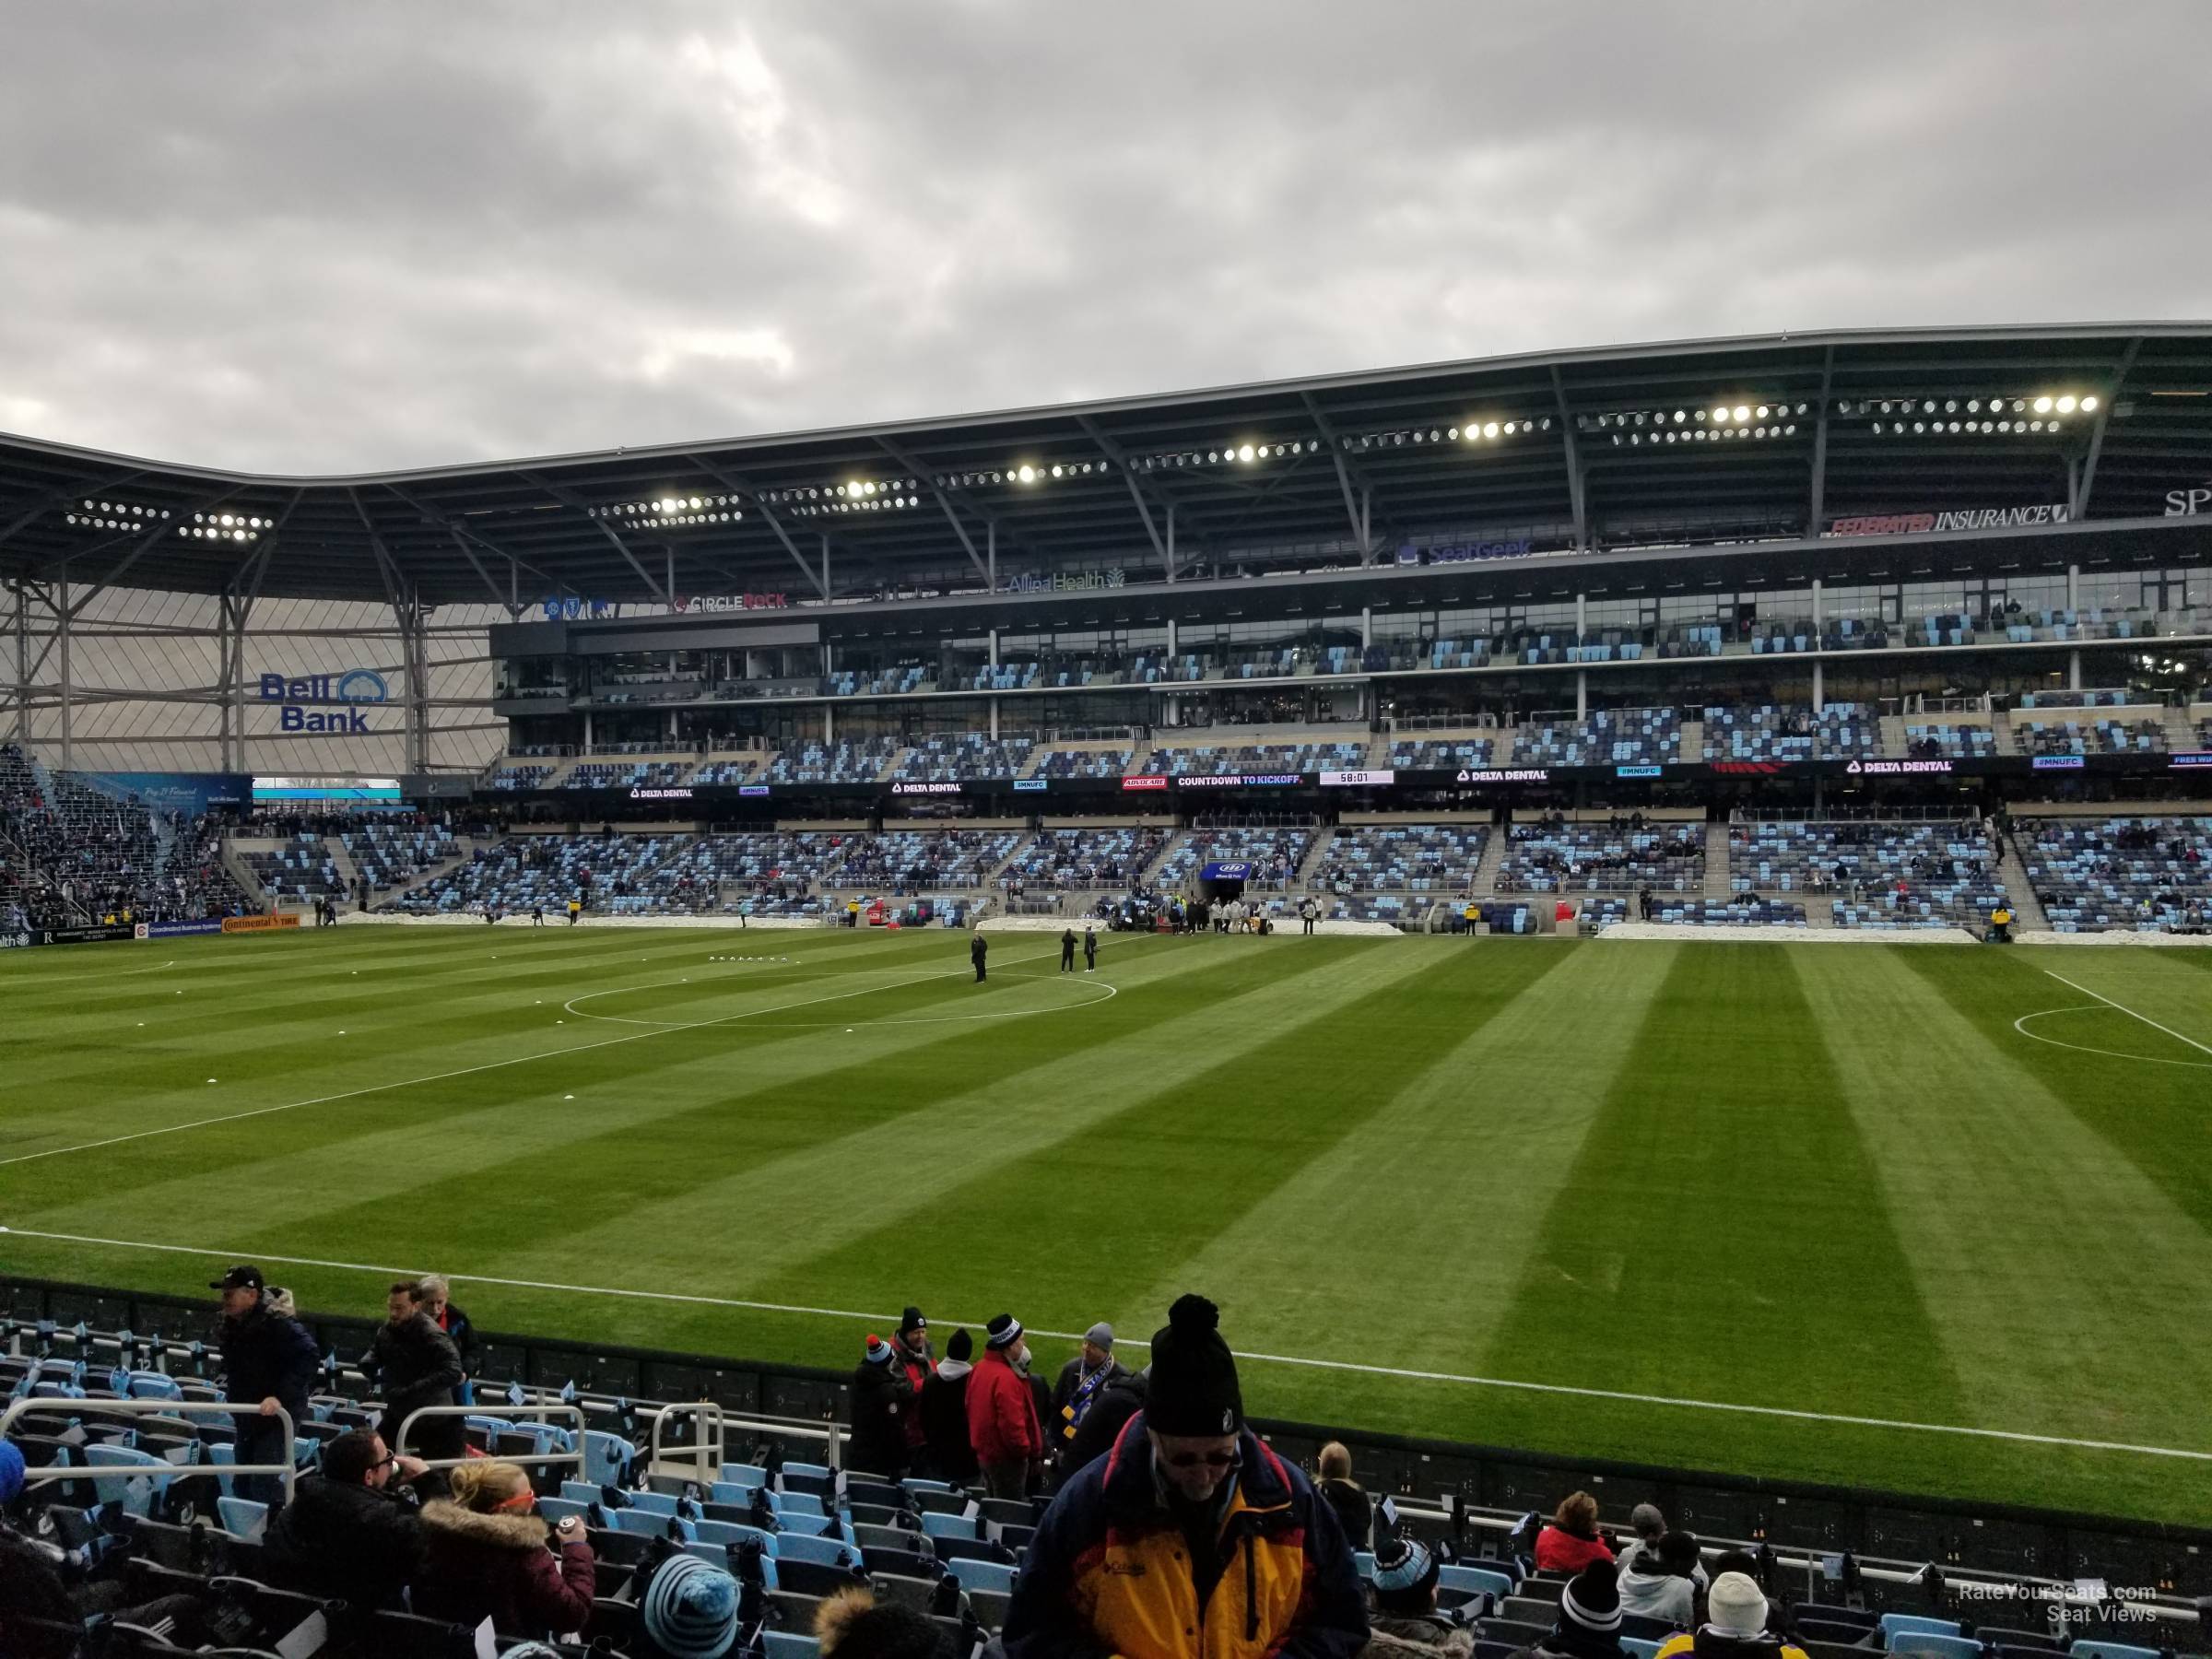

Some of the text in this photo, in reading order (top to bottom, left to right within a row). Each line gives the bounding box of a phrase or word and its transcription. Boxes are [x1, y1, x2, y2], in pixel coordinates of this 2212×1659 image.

[1830, 505, 2050, 535] FEDERATED INSURANCE
[1430, 539, 1533, 561] SeatGeek
[1007, 570, 1105, 593] Allina Health
[690, 593, 789, 612] CIRCLE ROCK
[261, 673, 330, 701] Bell
[281, 706, 369, 735] Bank
[1865, 761, 1952, 772] DELTA DENTAL
[1178, 777, 1241, 786] COUNTDOWN
[1243, 775, 1255, 784] TO
[1340, 772, 1368, 782] 58:01
[1472, 770, 1547, 781] DELTA DENTAL
[903, 783, 960, 793] DELTA DENTAL
[224, 919, 271, 932] Continental
[44, 932, 53, 944] R
